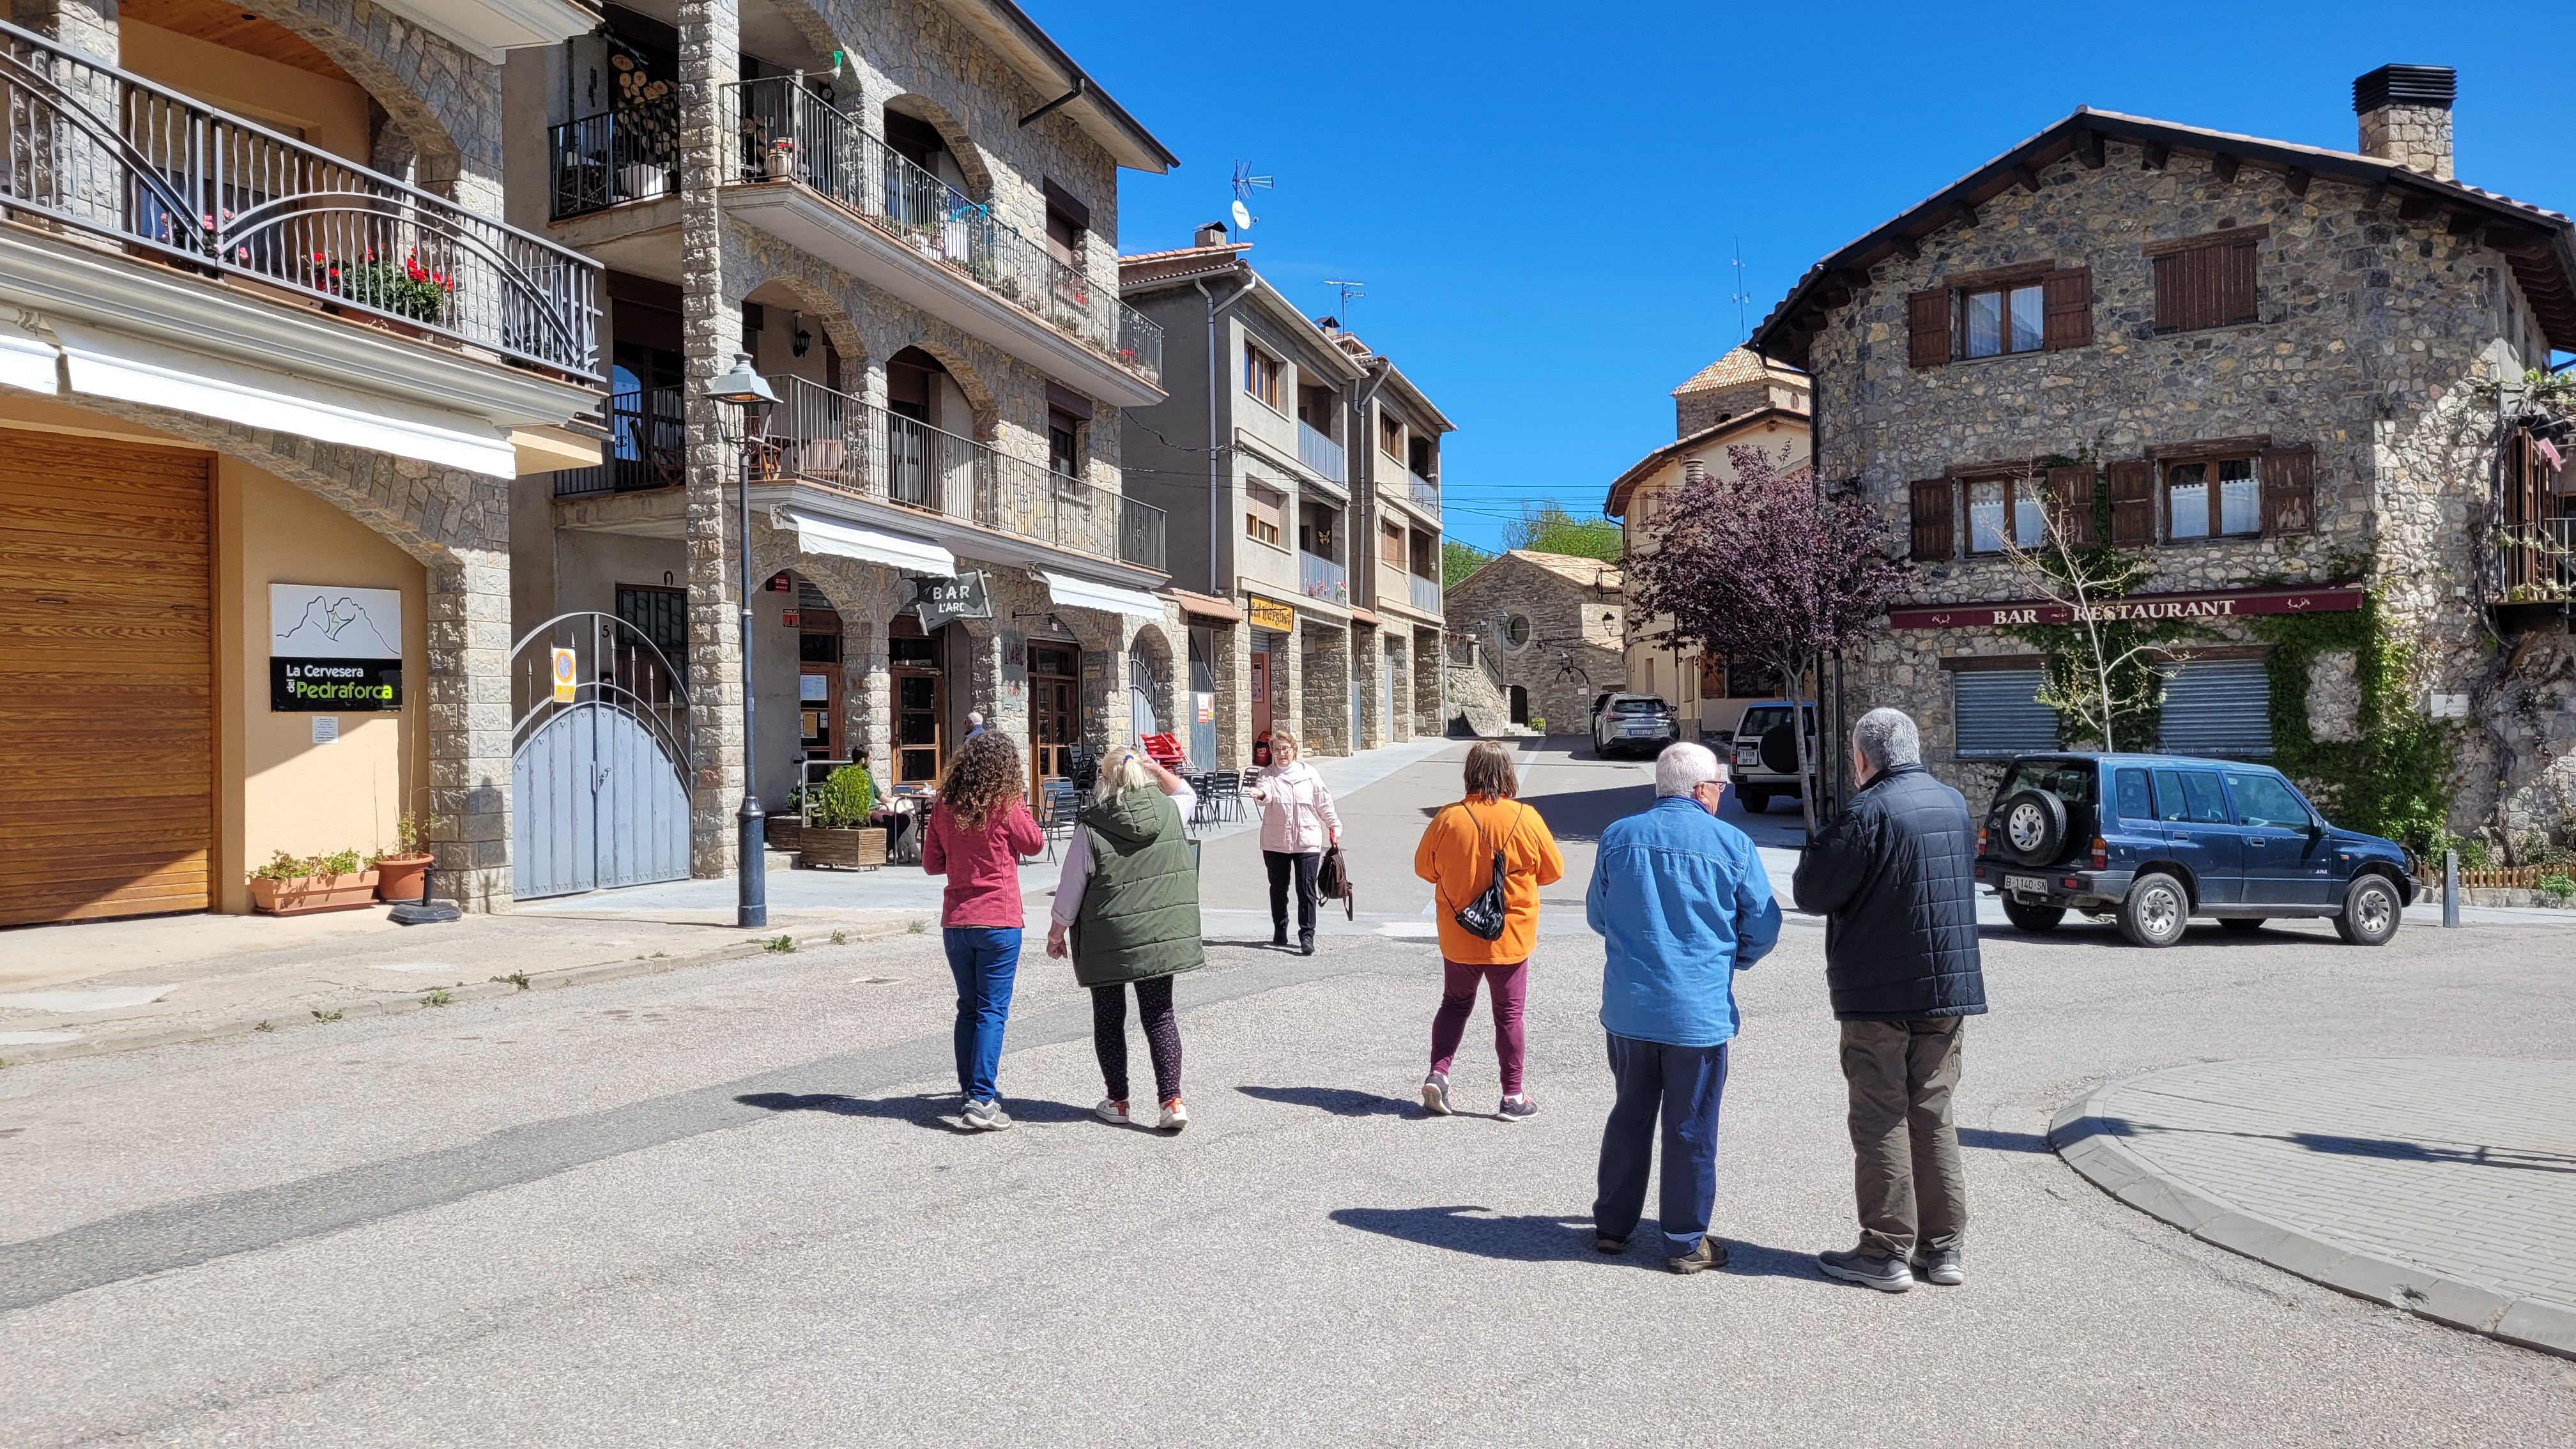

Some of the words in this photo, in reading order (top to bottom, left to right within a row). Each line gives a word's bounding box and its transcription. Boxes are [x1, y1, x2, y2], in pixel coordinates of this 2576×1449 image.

[933, 585, 970, 600] BAR
[937, 602, 965, 613] L'ARC
[1993, 610, 2039, 625] BAR
[2073, 600, 2235, 622] RESTAURANT
[602, 624, 610, 638] 5
[286, 664, 300, 677] La
[304, 665, 364, 678] Cervesera
[286, 679, 296, 693] del
[296, 681, 393, 699] Pedraforca
